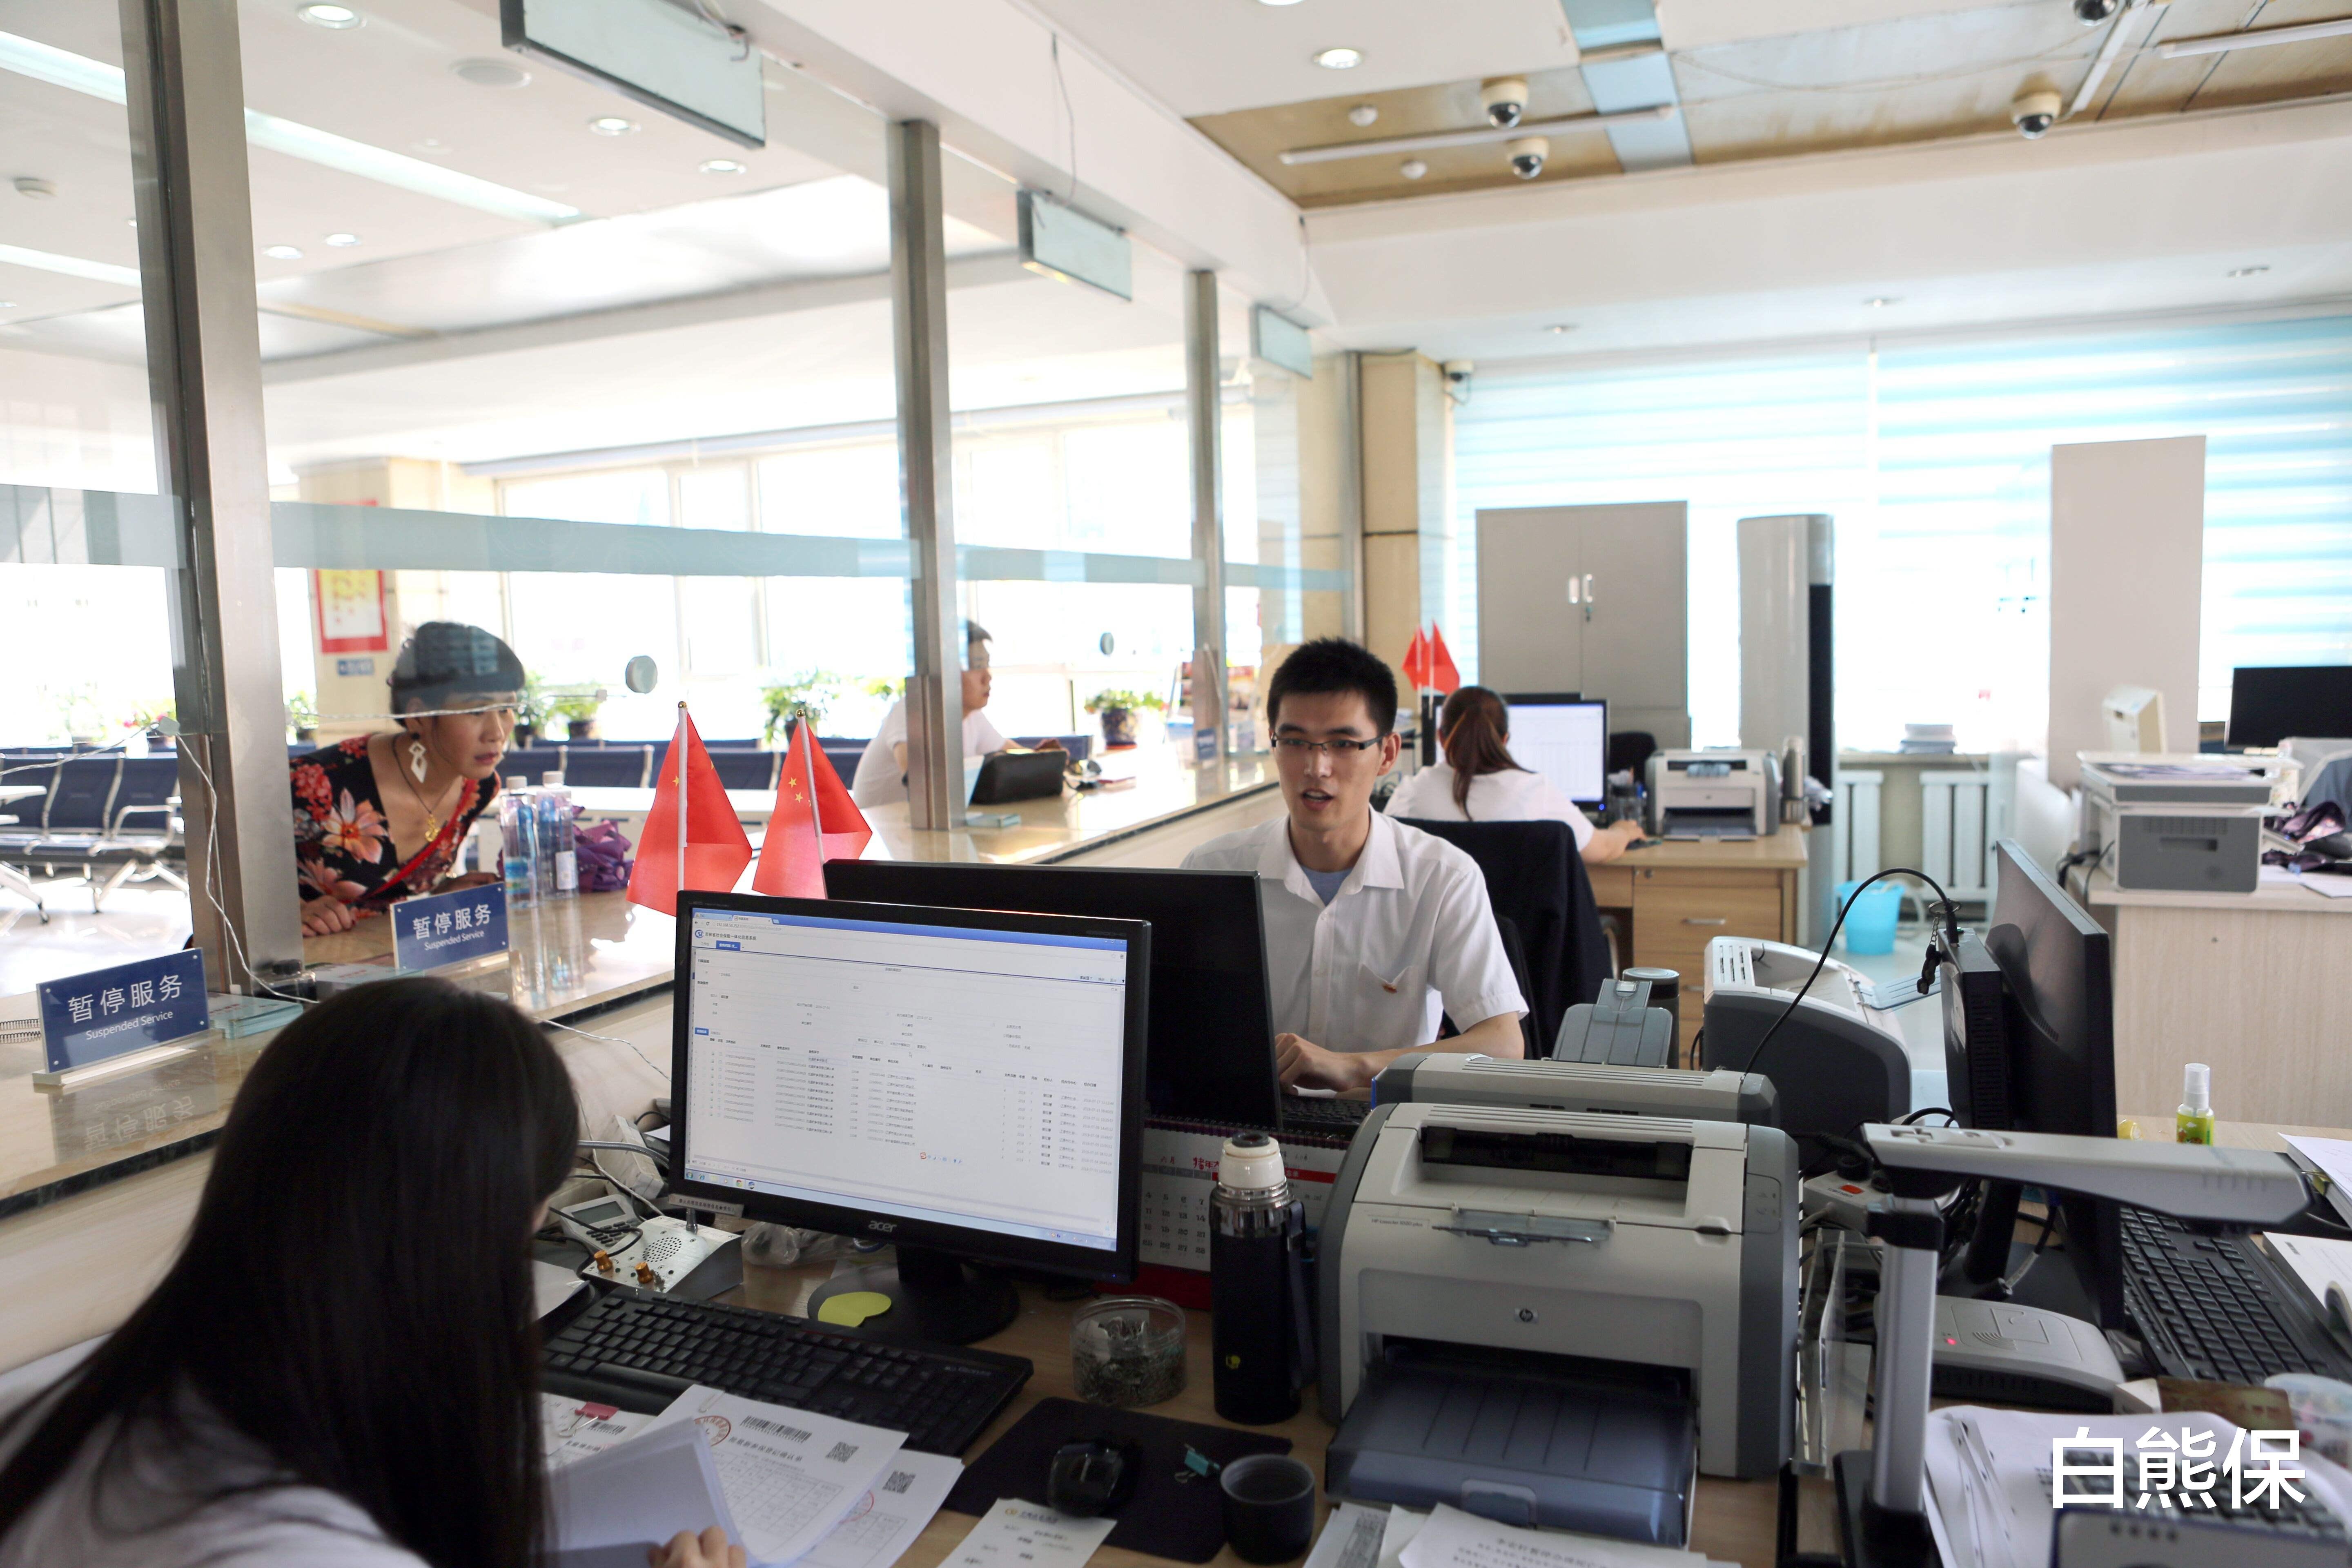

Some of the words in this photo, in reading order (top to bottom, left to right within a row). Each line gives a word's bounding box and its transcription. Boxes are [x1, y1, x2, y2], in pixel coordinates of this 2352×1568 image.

[412, 904, 491, 940] 暂停服务
[424, 935, 461, 951] Suspended
[461, 930, 485, 941] Service
[68, 975, 183, 1023] 暂停服务
[86, 1018, 139, 1040] Suspended
[141, 1011, 174, 1026] Service
[1161, 1156, 1175, 1165] 六月
[868, 1220, 897, 1233] acer
